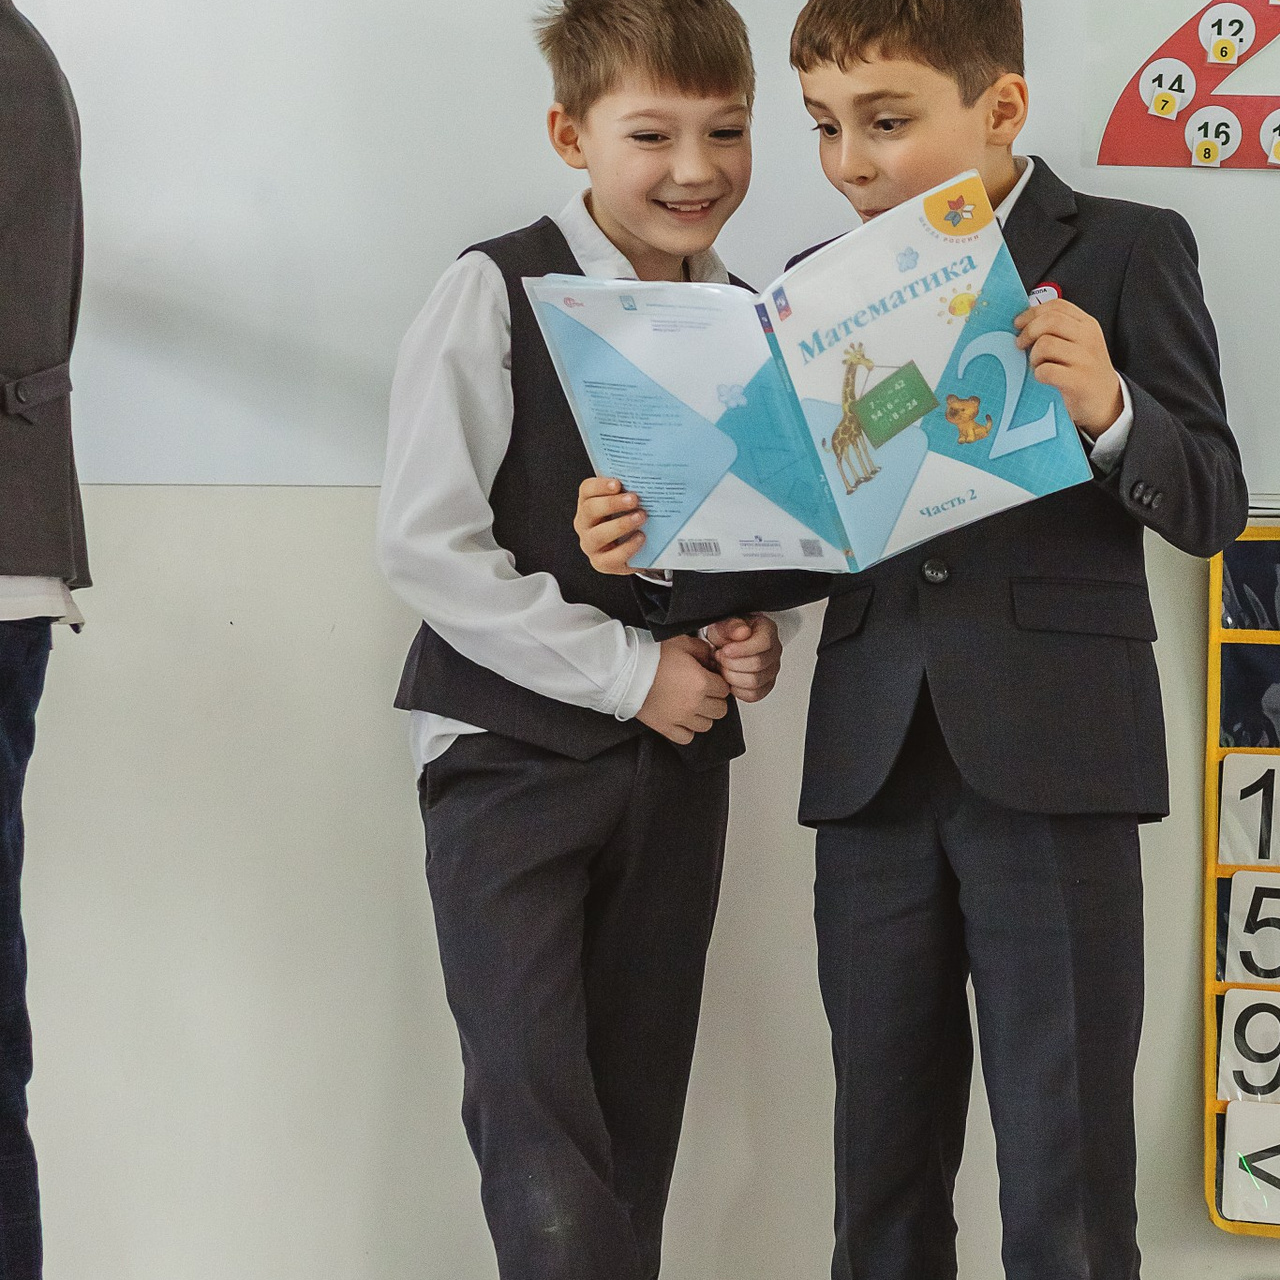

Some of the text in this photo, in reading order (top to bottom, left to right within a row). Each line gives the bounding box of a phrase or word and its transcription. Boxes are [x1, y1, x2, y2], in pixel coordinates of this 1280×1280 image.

[1220, 46, 1228, 58] 6
[1203, 148, 1211, 159] 8
[797, 253, 978, 367] Математика
[957, 330, 1058, 461] 2
[919, 488, 978, 519] Часть 2
[1238, 769, 1276, 861] 1
